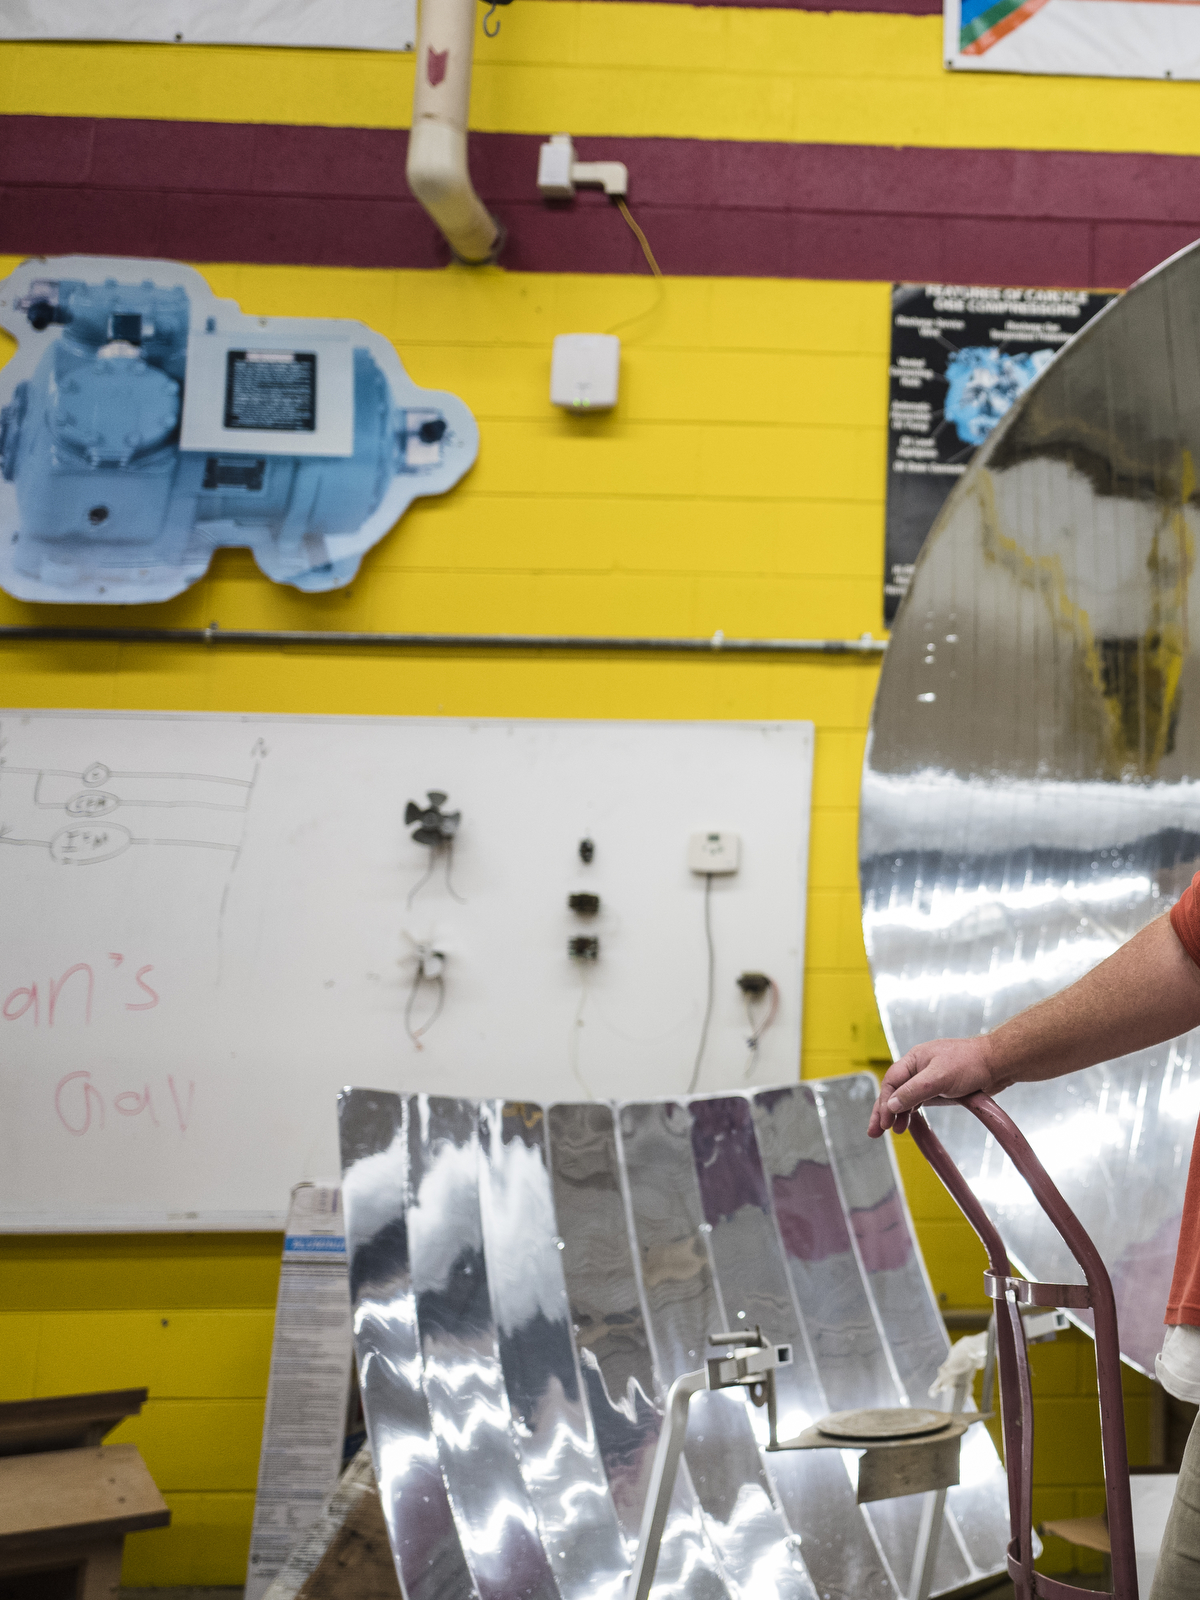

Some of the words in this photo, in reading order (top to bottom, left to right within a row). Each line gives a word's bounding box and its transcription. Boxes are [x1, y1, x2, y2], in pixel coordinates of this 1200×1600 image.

[925, 285, 1001, 300] FEATURES
[1003, 288, 1022, 301] OF
[967, 299, 1081, 316] COMPRESSORS
